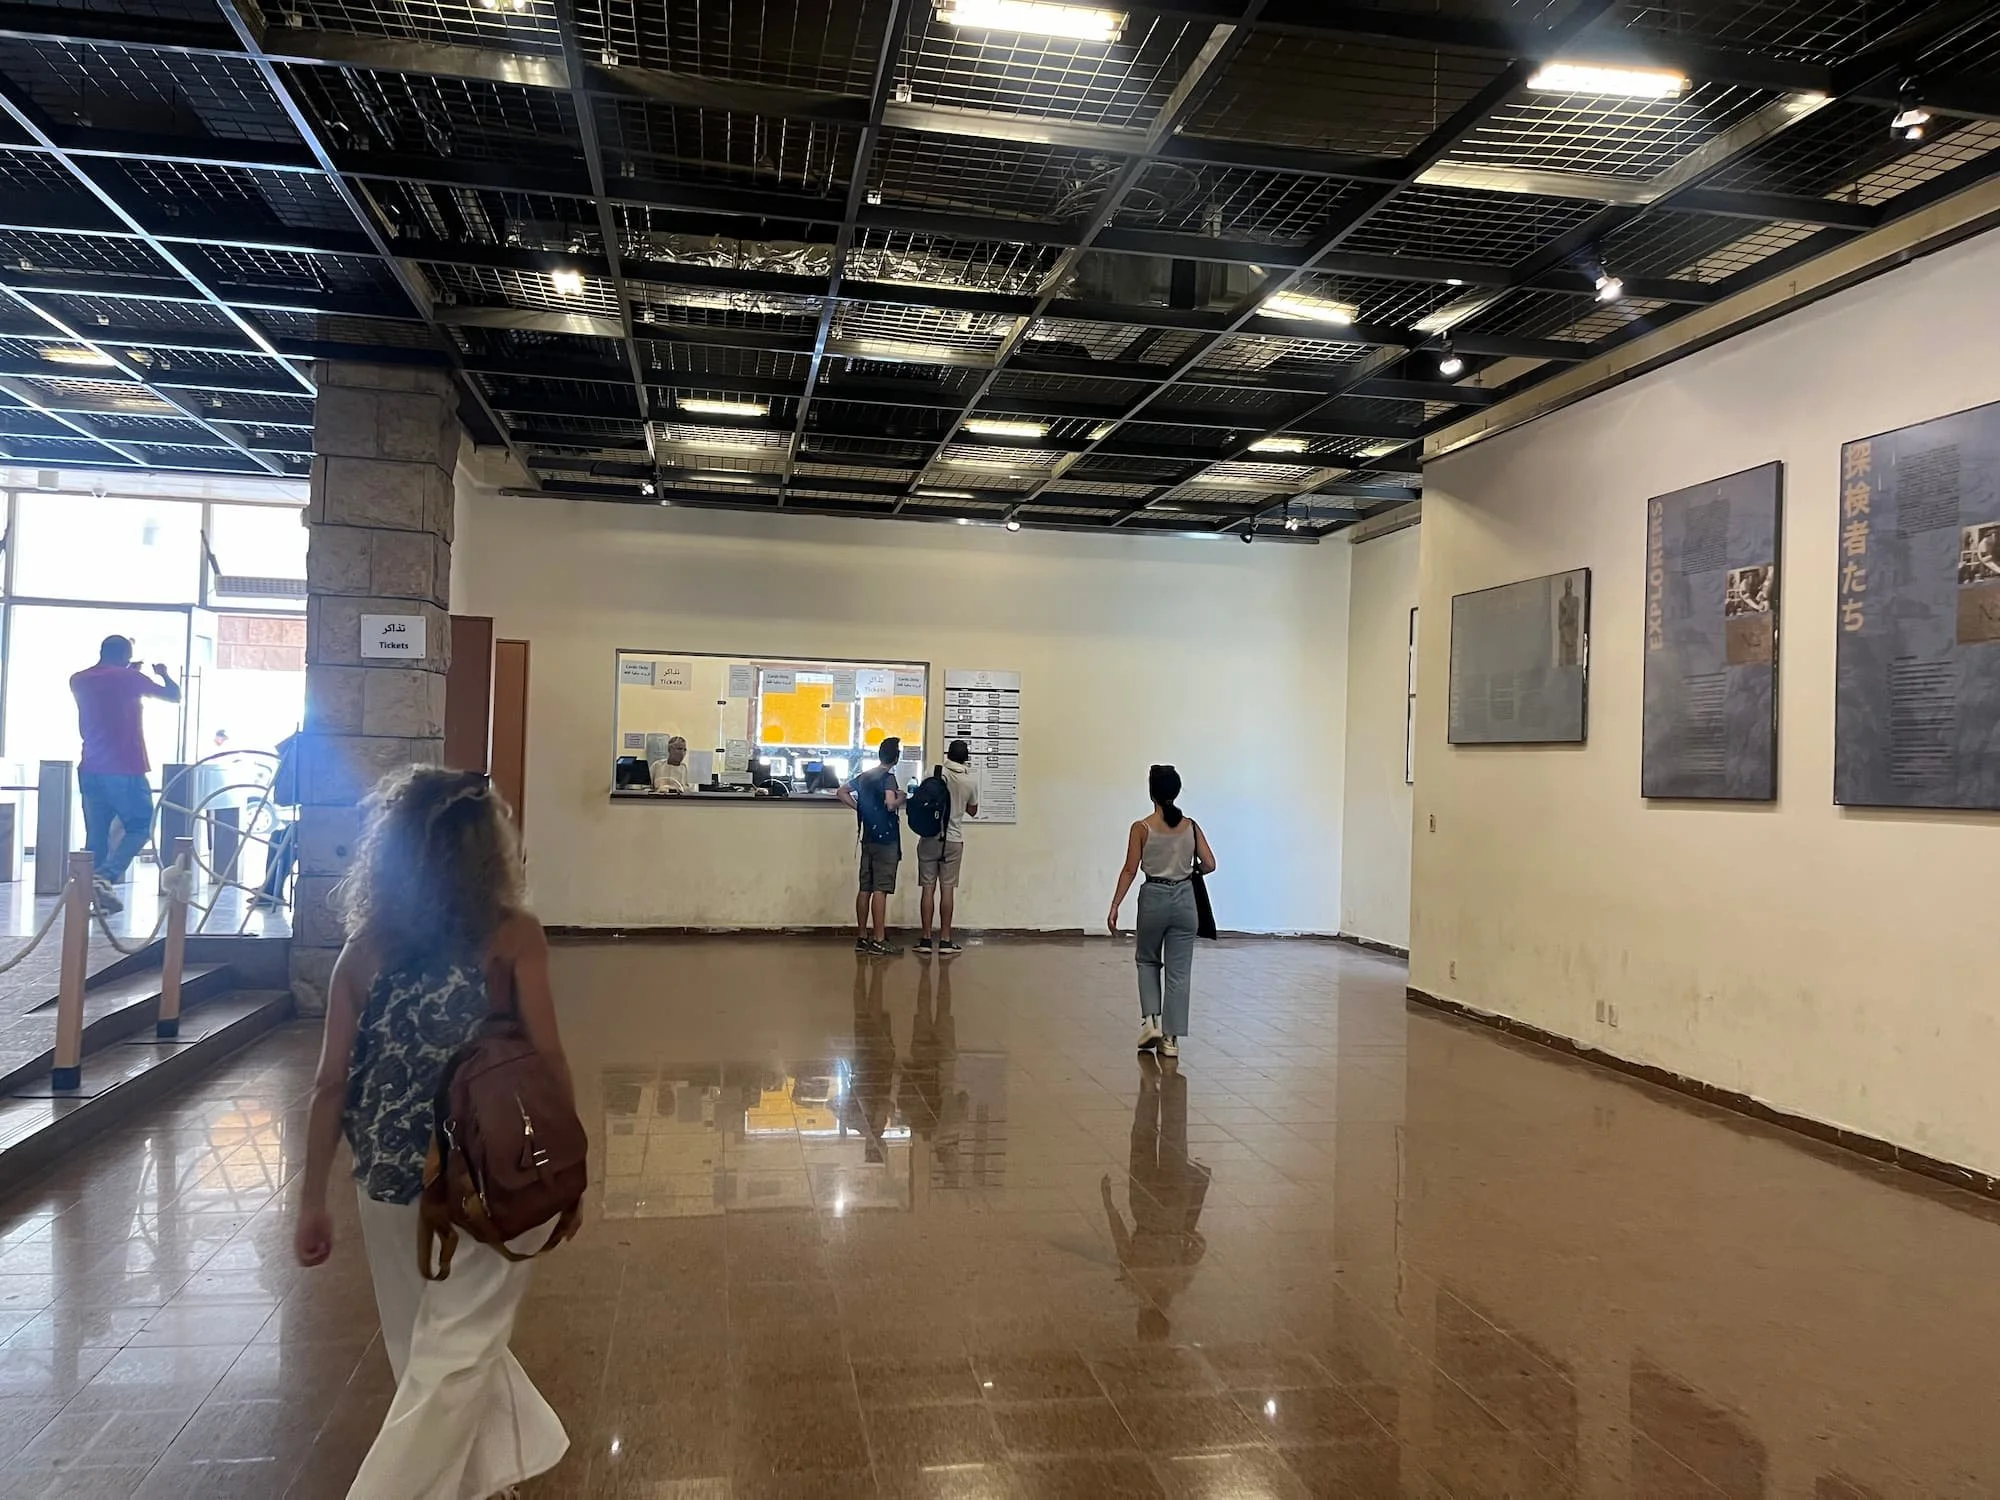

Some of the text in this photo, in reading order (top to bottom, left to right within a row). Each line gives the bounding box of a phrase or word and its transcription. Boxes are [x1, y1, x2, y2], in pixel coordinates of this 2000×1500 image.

[1841, 441, 1871, 631] 探検者たち
[1649, 501, 1664, 650] EXPLORERS
[381, 623, 406, 634] تذاكر
[379, 641, 409, 649] Tickets
[663, 668, 680, 677] تذاكر
